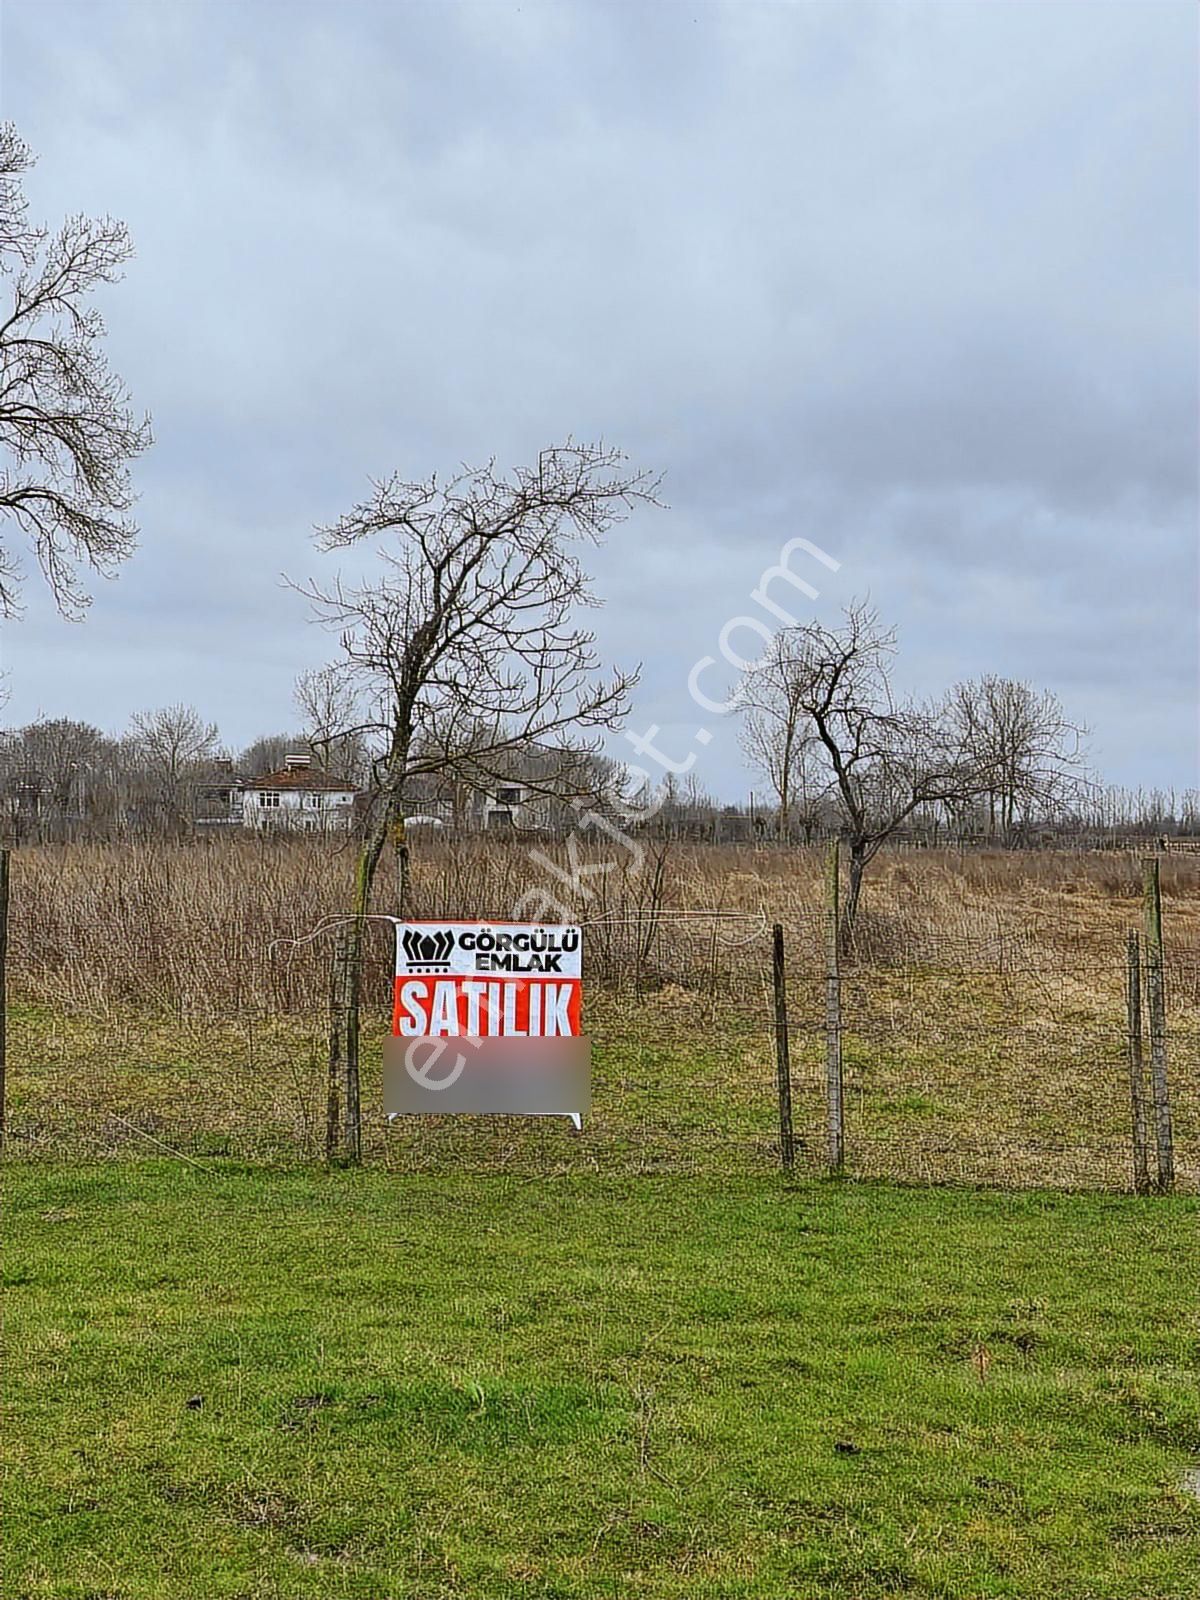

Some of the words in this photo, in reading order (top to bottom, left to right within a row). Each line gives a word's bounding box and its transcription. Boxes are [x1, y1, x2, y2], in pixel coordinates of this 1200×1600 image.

[458, 928, 579, 952] GÖRGÜLÜ
[475, 953, 562, 972] EMLAK
[399, 980, 573, 1036] SATILIK
